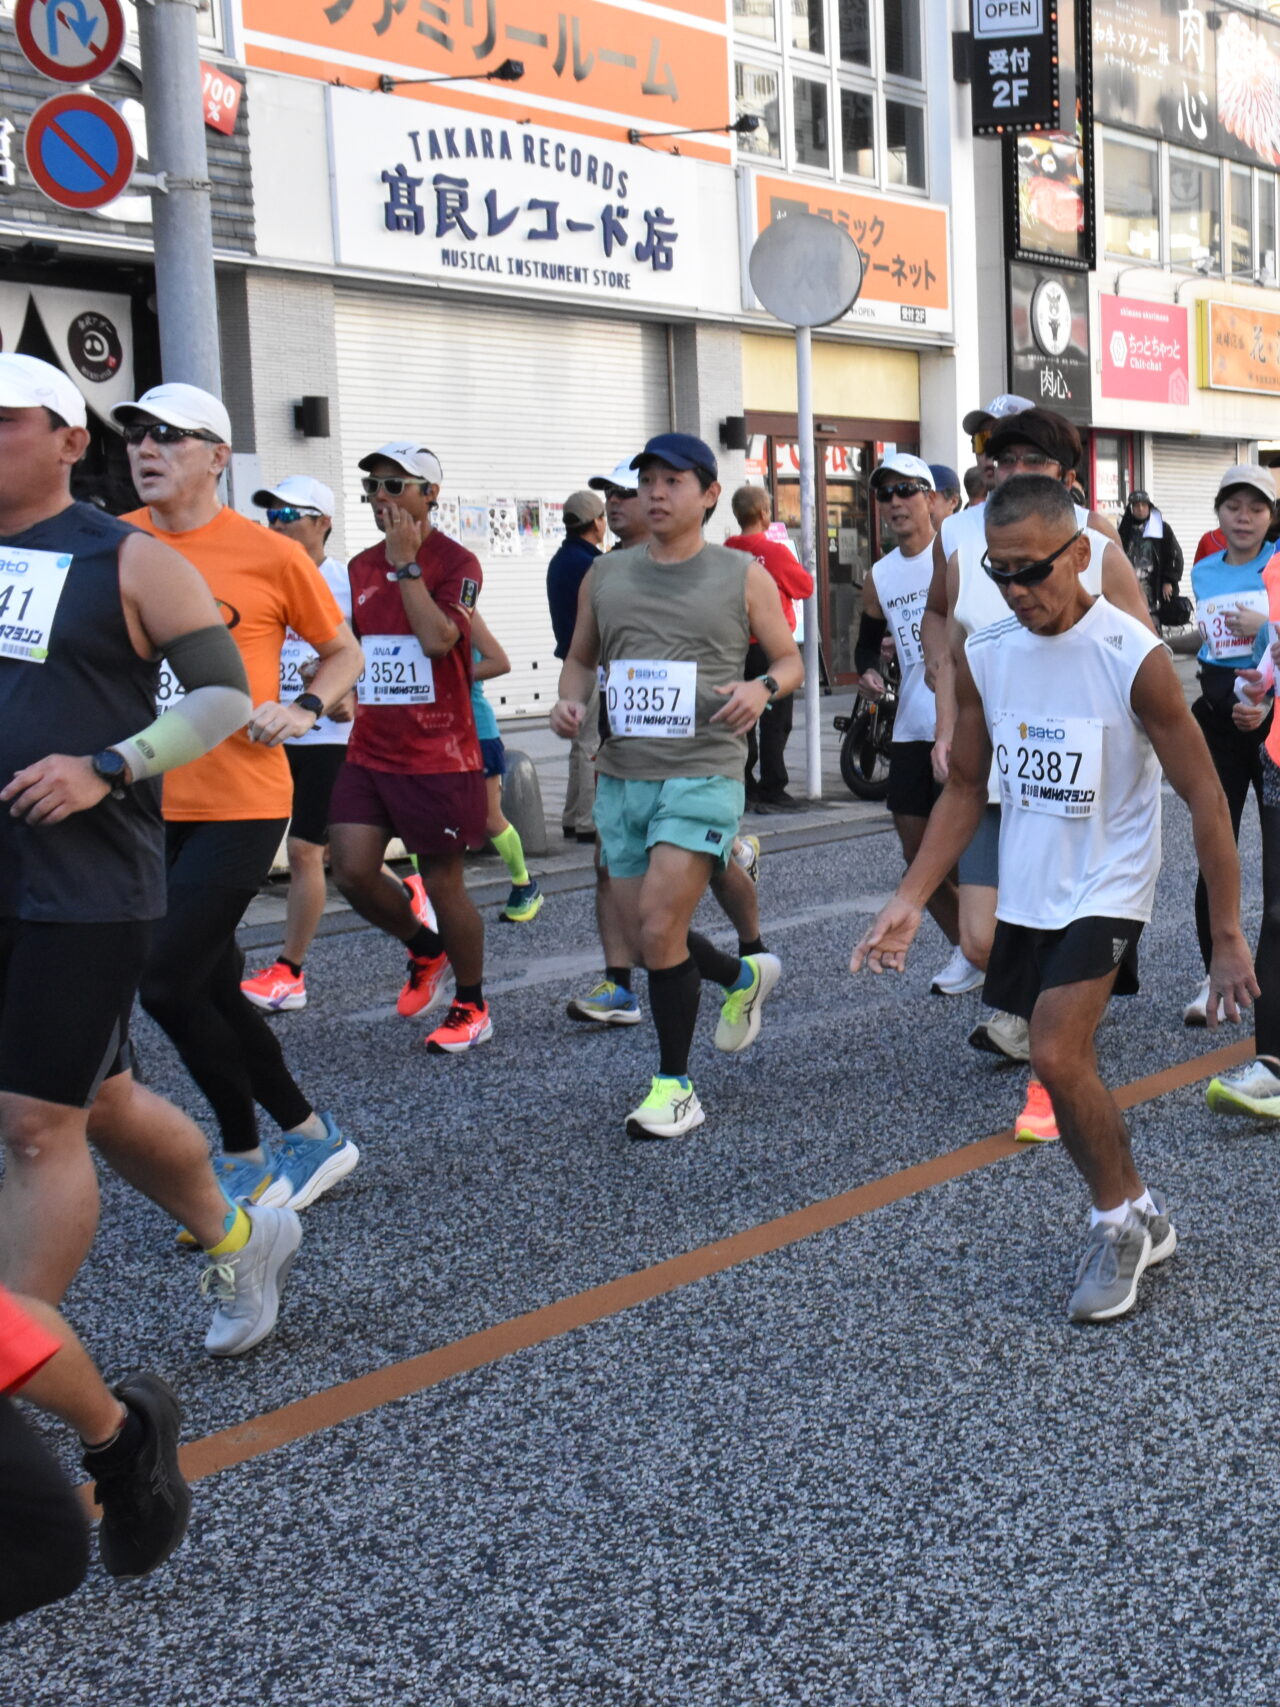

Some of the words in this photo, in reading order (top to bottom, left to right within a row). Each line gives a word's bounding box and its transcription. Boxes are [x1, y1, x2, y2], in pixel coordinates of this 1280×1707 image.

[985, 1, 1031, 18] OPEN
[988, 47, 1031, 75] 受付
[203, 72, 237, 108] 100
[992, 79, 1029, 108] 2F
[408, 128, 513, 162] TAKARA
[523, 134, 629, 199] RECORDS
[441, 248, 502, 273] MUSICAL
[508, 257, 589, 283] INSTRUMENT
[593, 268, 632, 290] STORE
[915, 309, 926, 323] 2F
[1129, 333, 1182, 359] ちっとちゃっと
[1040, 365, 1068, 399] 肉心
[897, 625, 909, 647] E
[373, 647, 391, 655] ANA
[371, 661, 417, 683] 3521
[608, 686, 618, 711] D
[623, 686, 681, 712] 3357
[1028, 726, 1066, 740] sato
[996, 743, 1009, 776] C
[1017, 746, 1083, 785] 2387
[1039, 785, 1096, 803] NAHAマラソン
